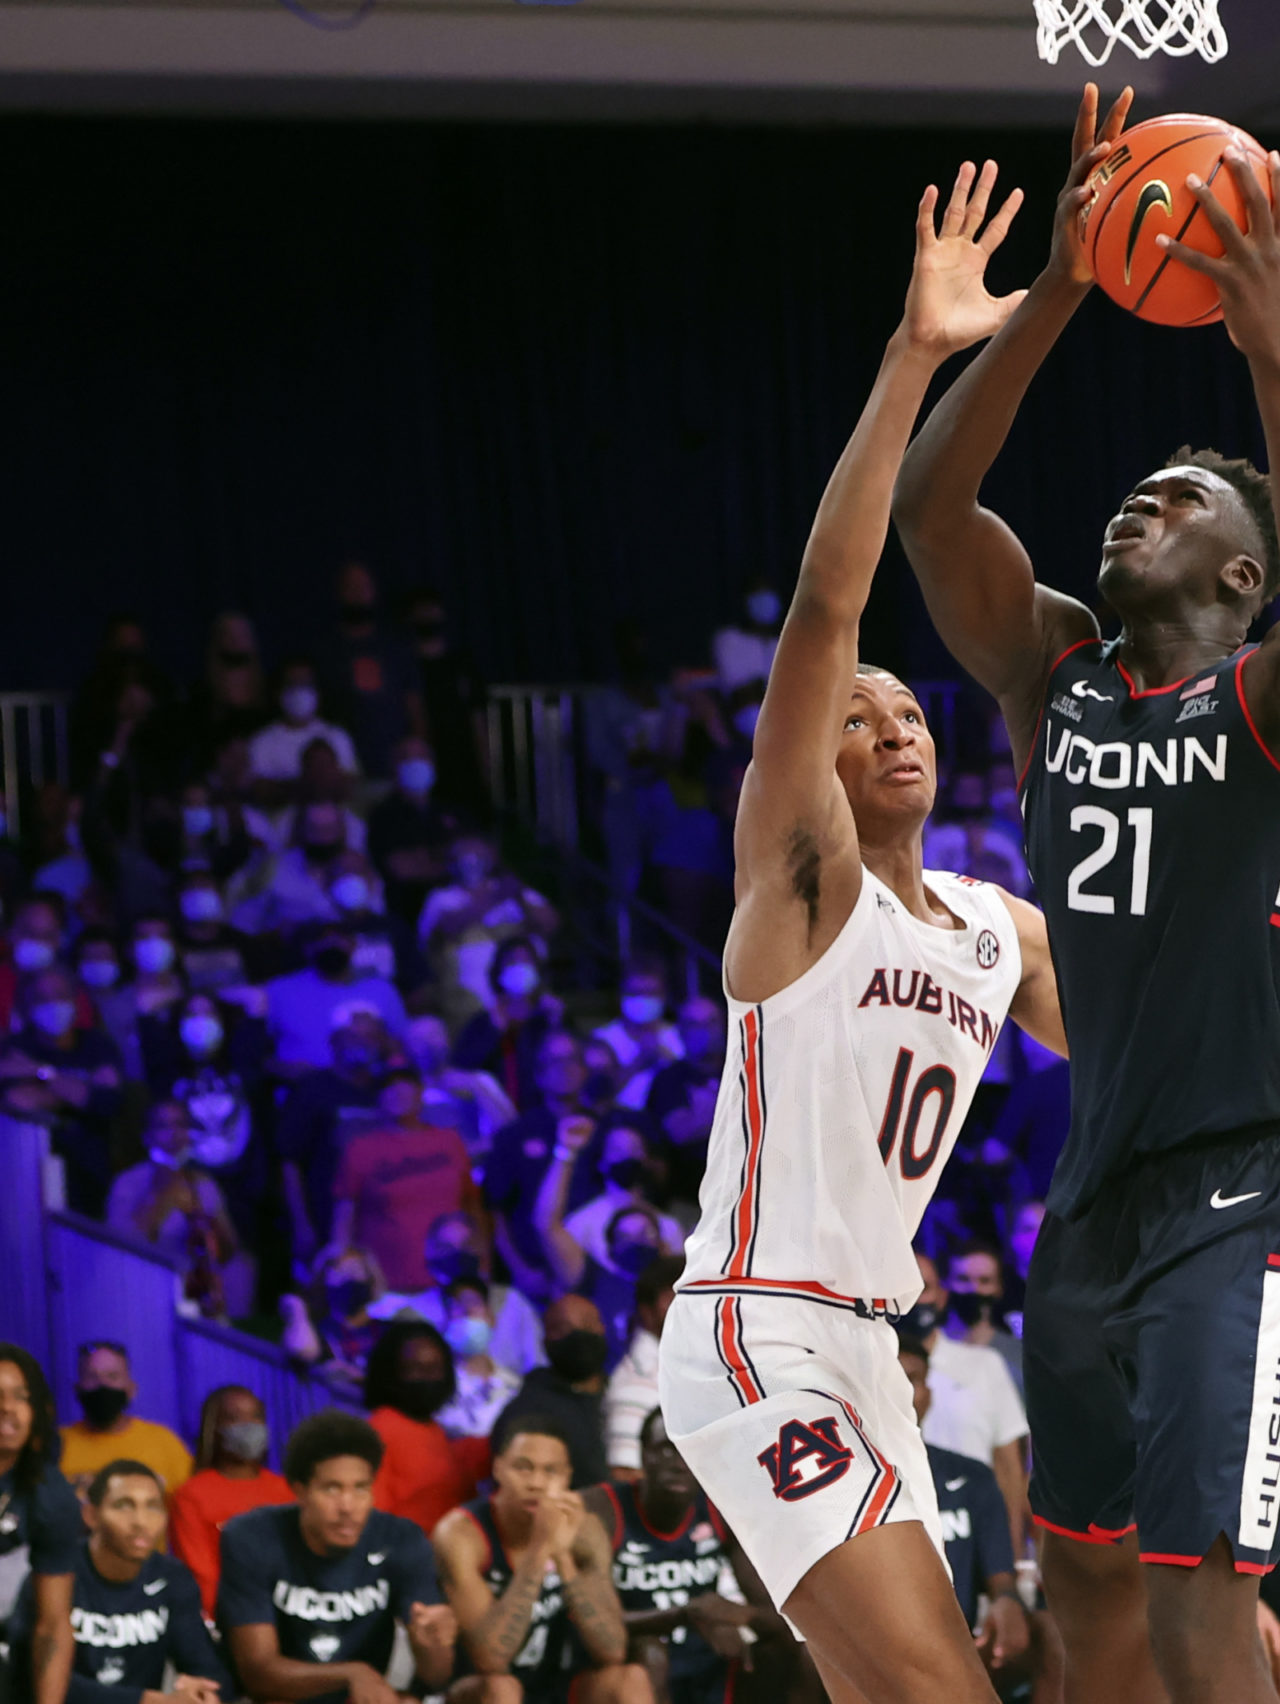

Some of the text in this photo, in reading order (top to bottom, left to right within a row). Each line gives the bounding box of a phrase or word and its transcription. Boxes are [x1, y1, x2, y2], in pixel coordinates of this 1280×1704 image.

[1045, 719, 1227, 789] UCONN
[1067, 805, 1153, 915] 21
[877, 1046, 957, 1181] 10
[272, 1579, 390, 1621] UCONN
